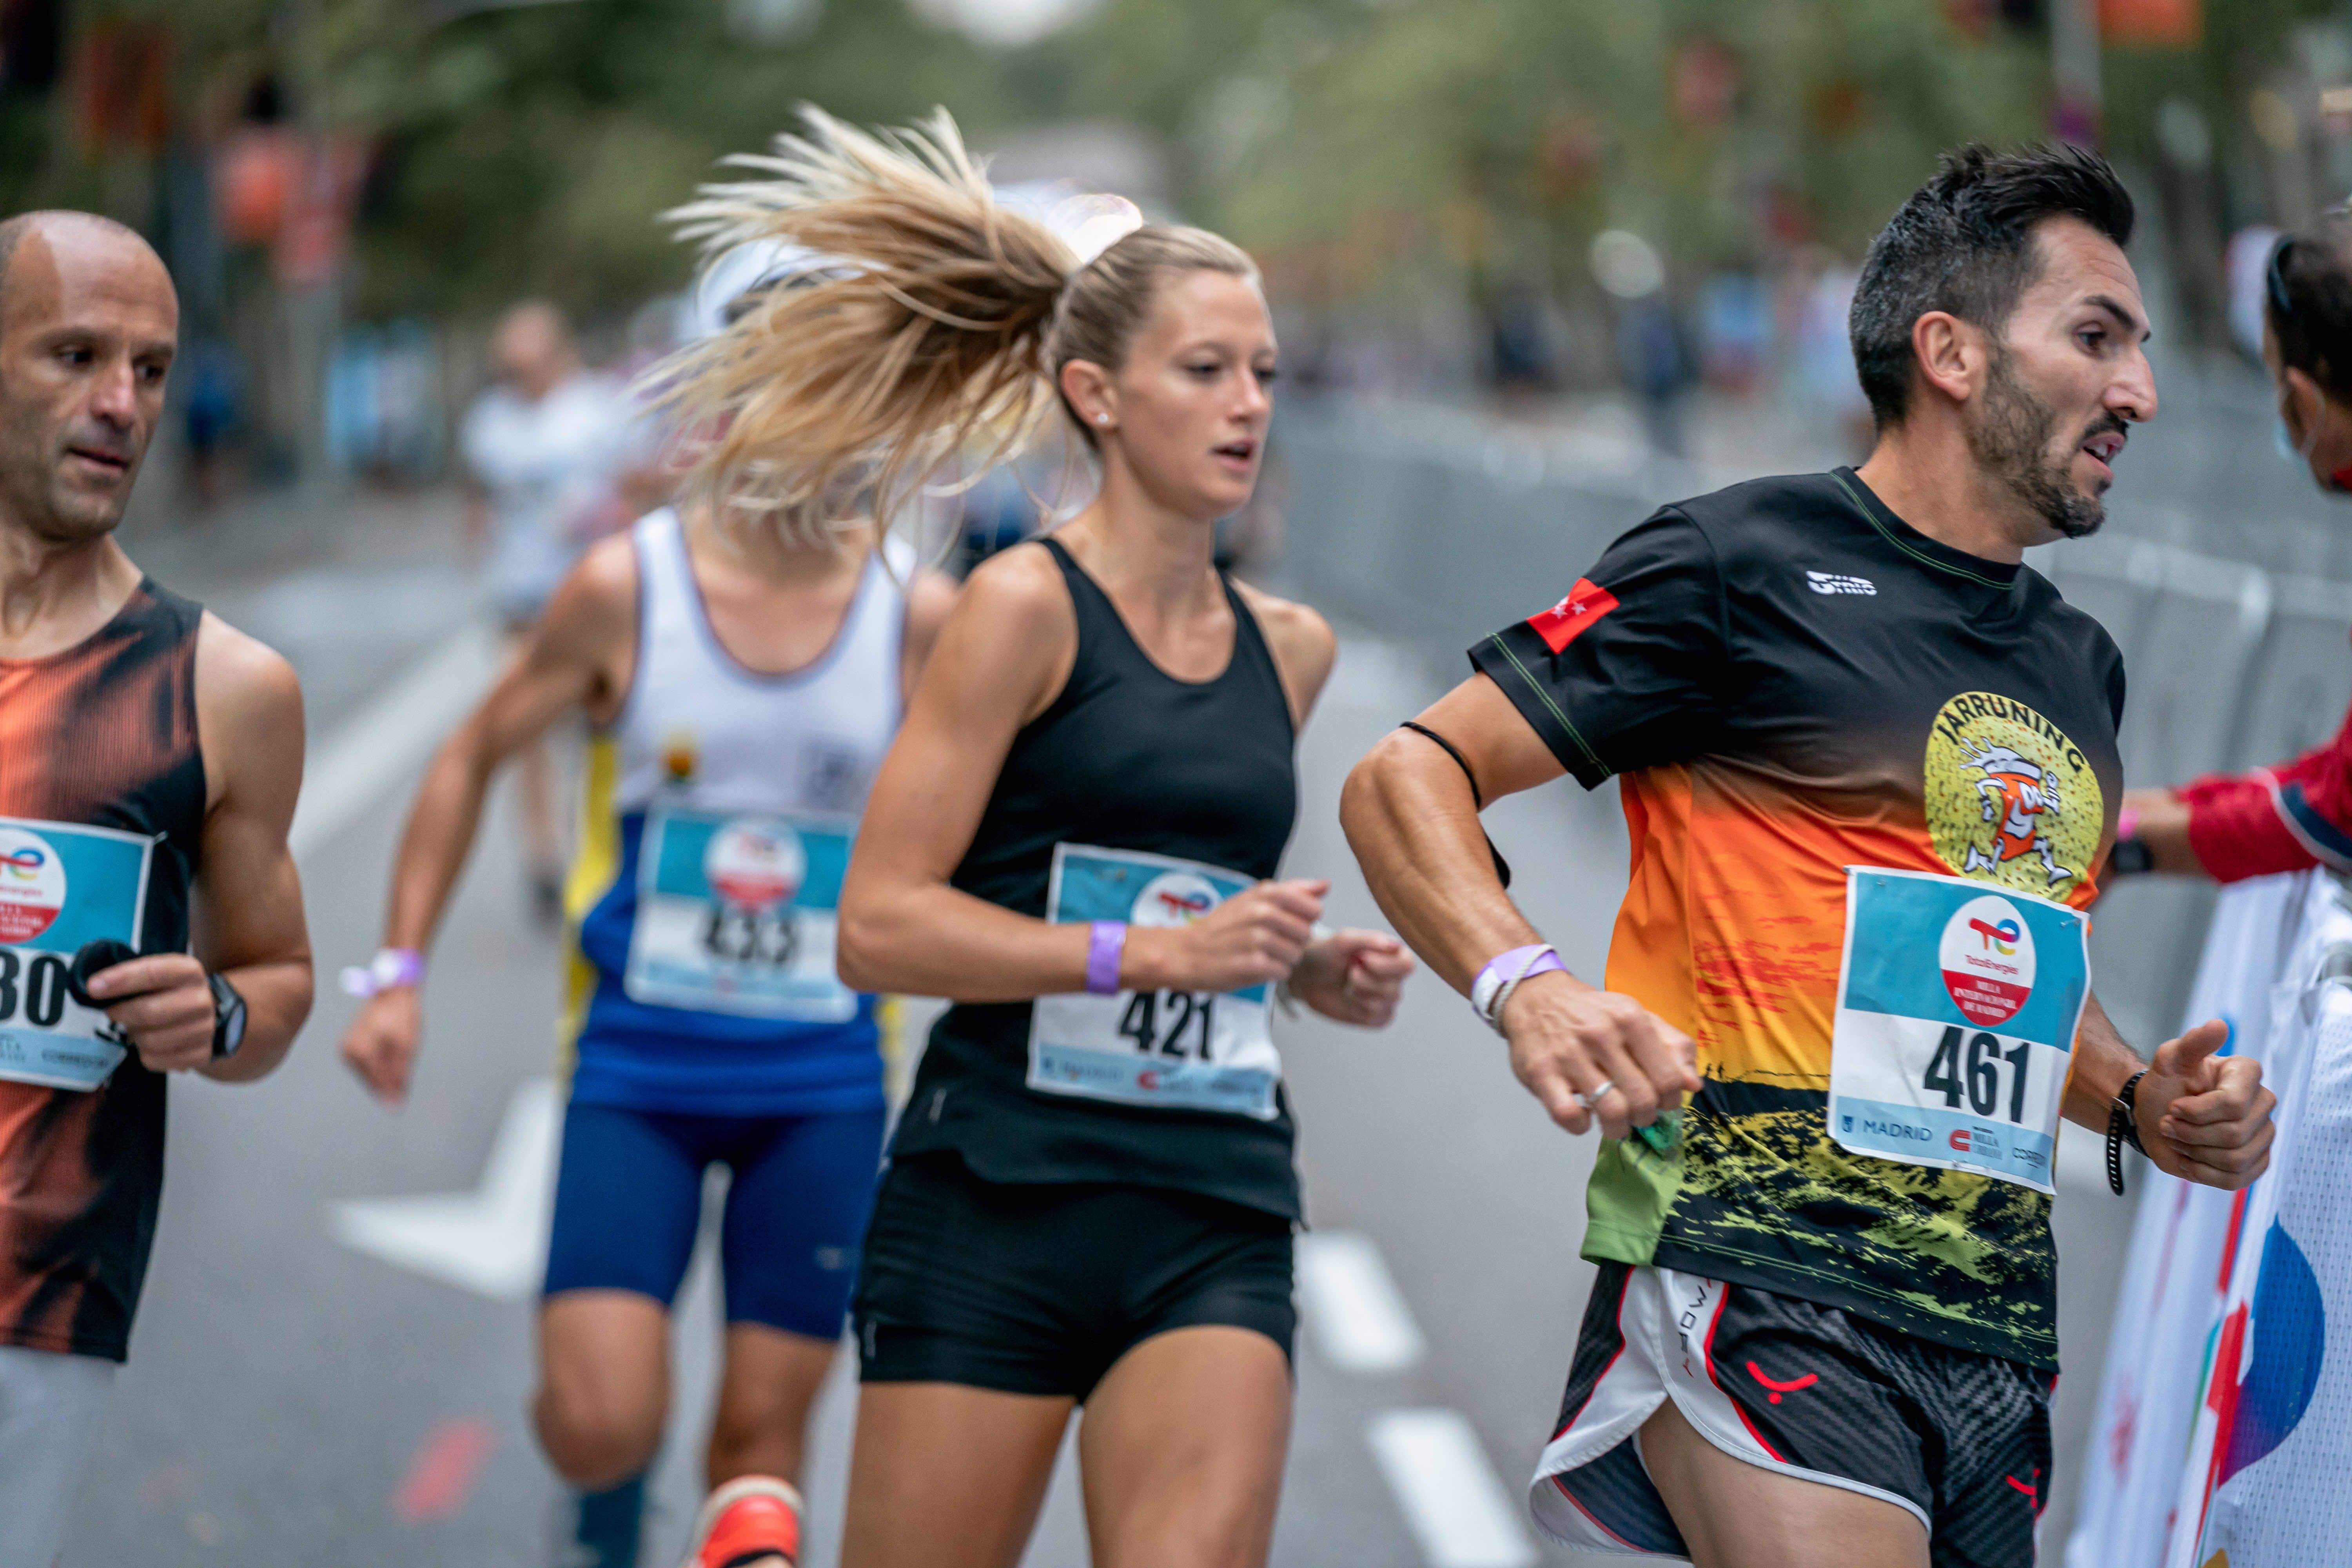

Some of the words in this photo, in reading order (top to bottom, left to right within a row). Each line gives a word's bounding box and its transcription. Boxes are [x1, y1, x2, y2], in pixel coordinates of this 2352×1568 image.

[1117, 992, 1215, 1062] 421
[1924, 1026, 2031, 1124] 461
[1864, 1120, 1933, 1142] MADRID
